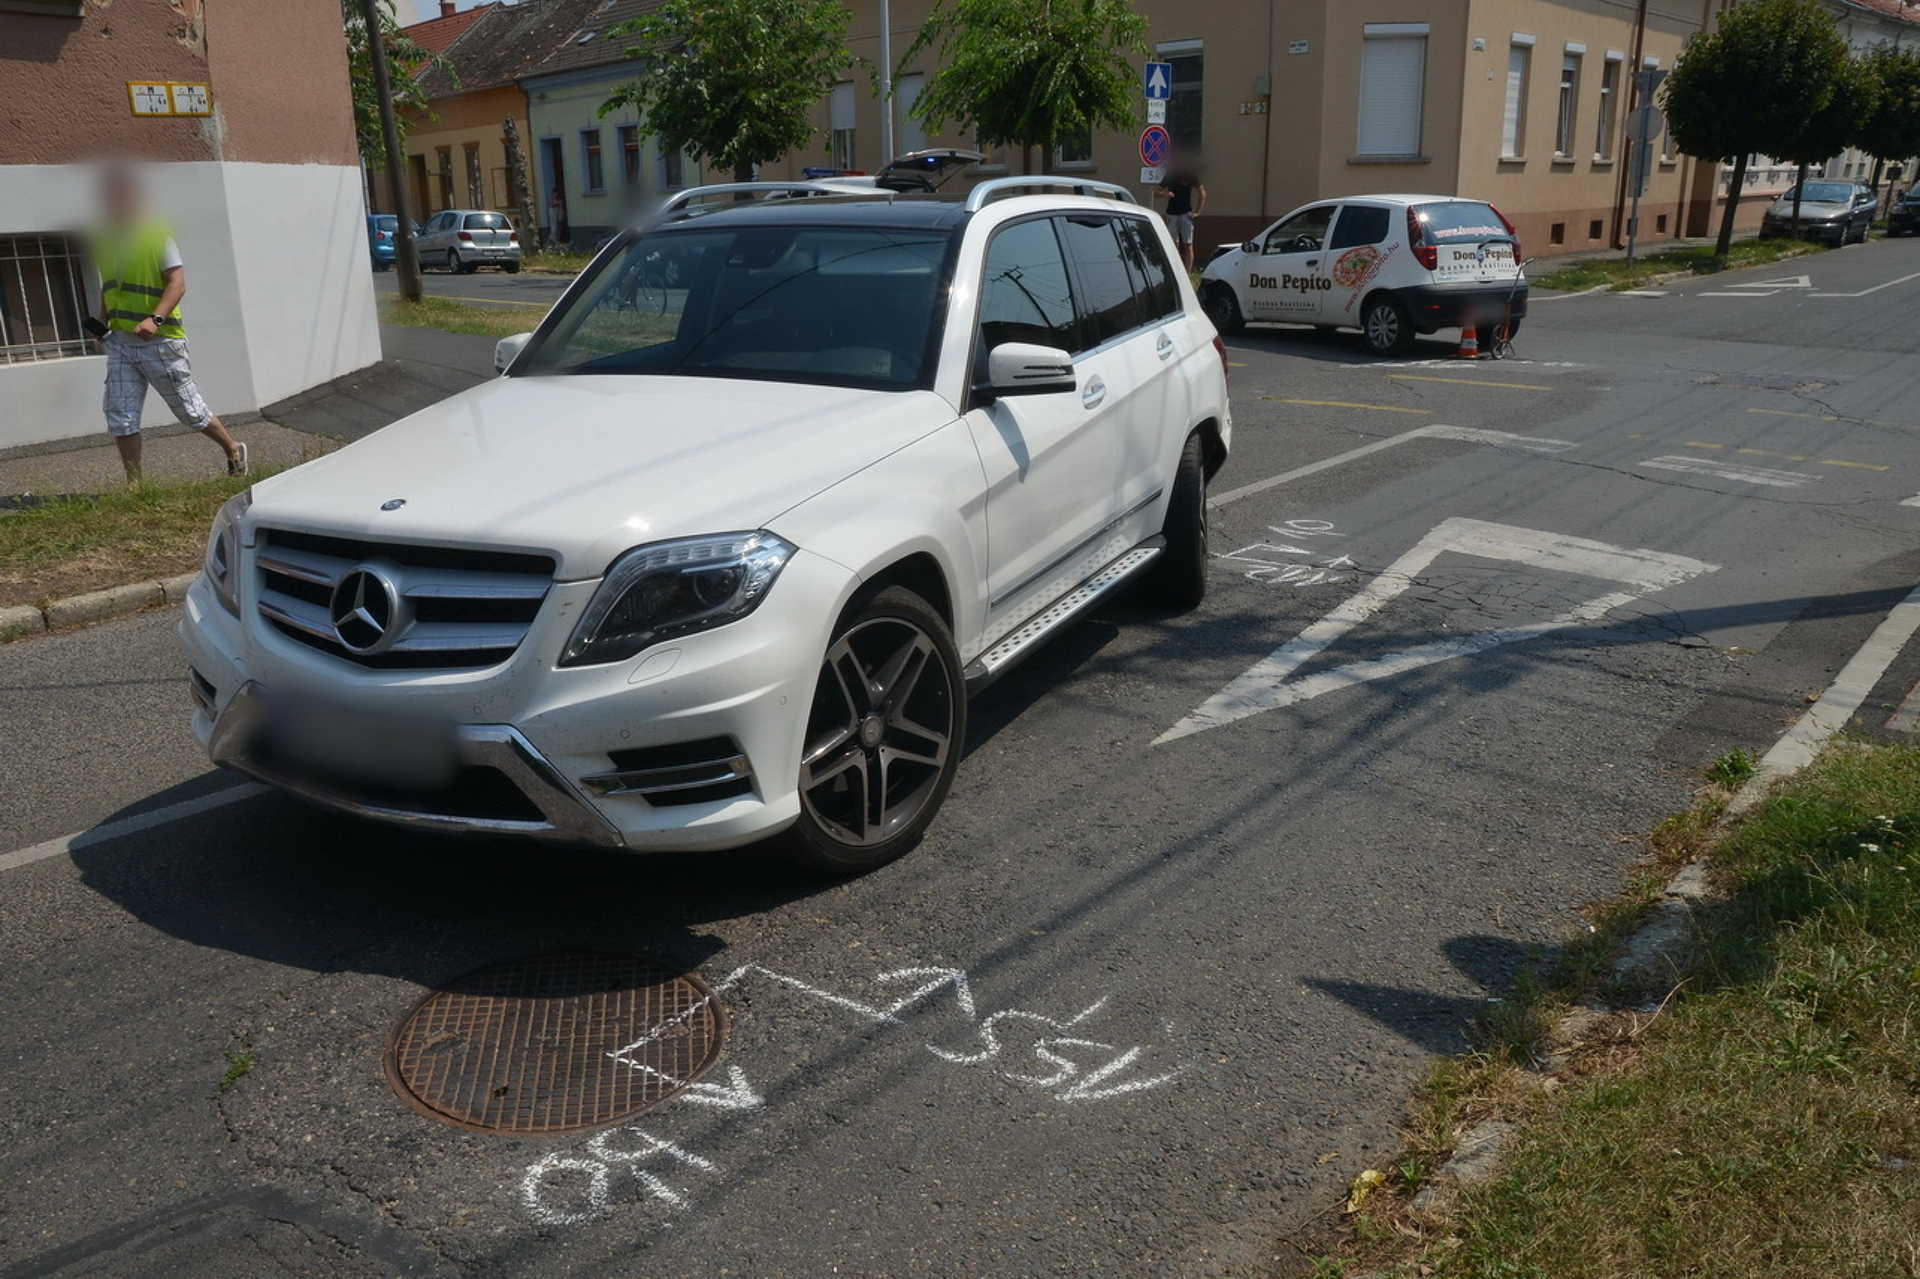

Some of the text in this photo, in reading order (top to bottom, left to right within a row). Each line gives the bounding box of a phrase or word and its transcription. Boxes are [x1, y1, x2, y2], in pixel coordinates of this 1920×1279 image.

[1453, 247, 1513, 261] Don Pepito
[1249, 272, 1332, 294] Don Pepito
